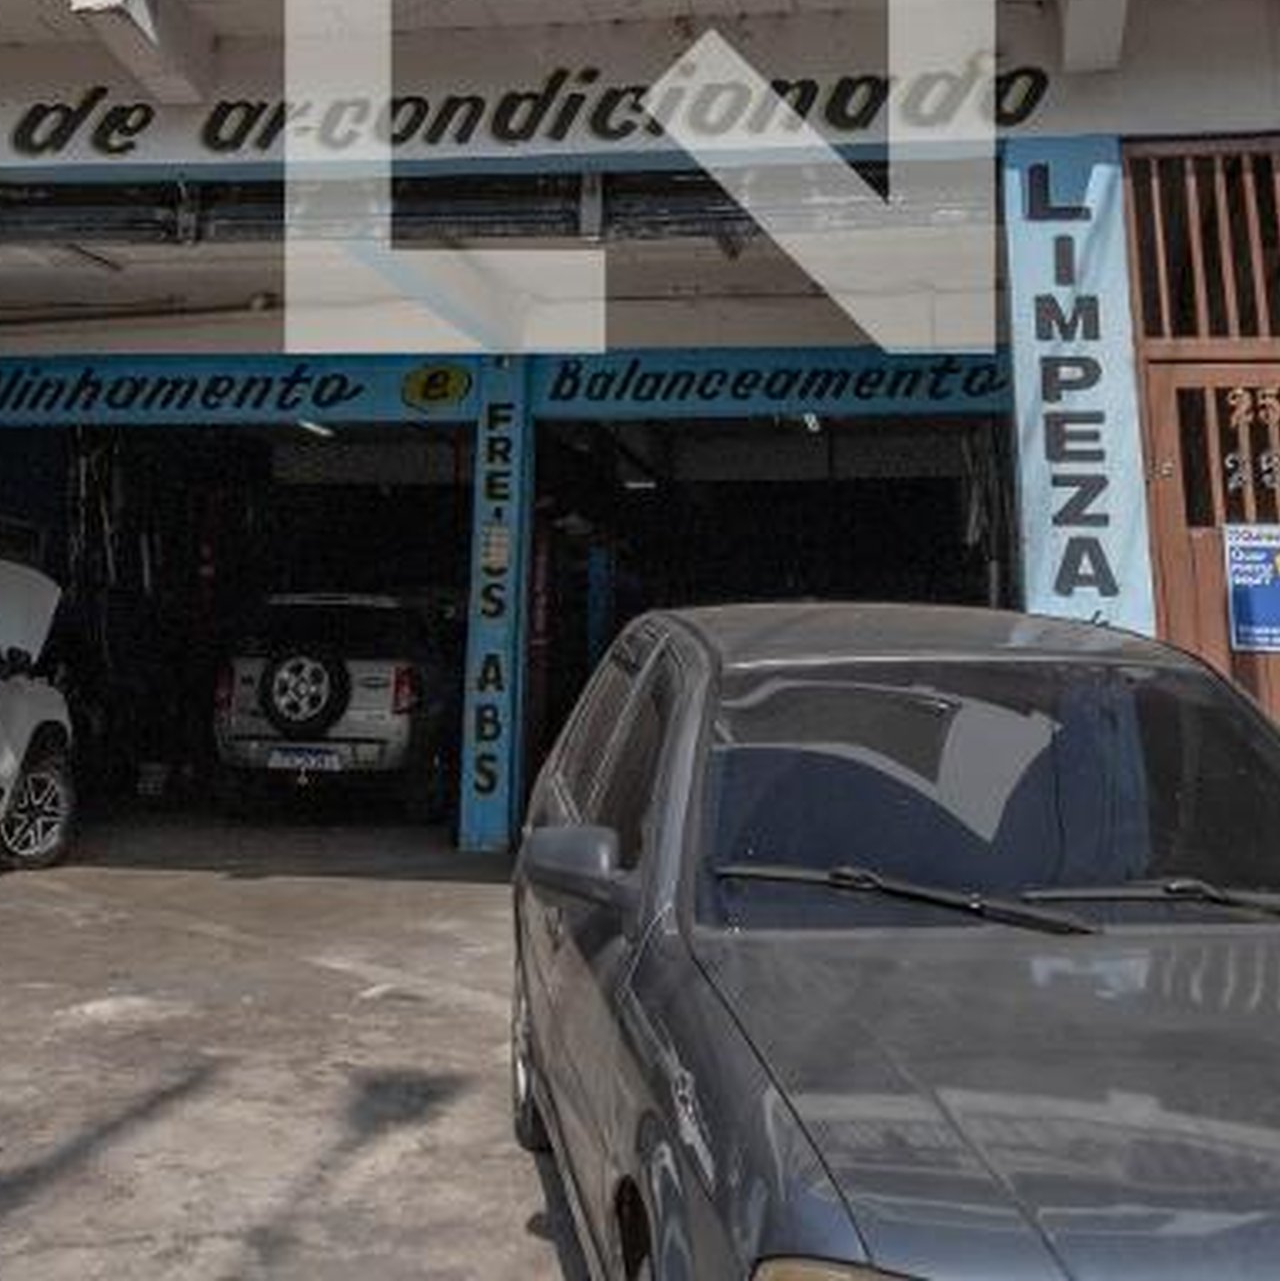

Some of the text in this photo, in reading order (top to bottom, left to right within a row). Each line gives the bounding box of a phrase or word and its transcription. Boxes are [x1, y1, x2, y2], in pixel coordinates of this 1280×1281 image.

[11, 85, 157, 162] de
[420, 369, 455, 401] e
[549, 355, 1008, 402] Balanceamento
[1027, 163, 1118, 597] LIMPEZA
[473, 403, 517, 794] FRES ABS
